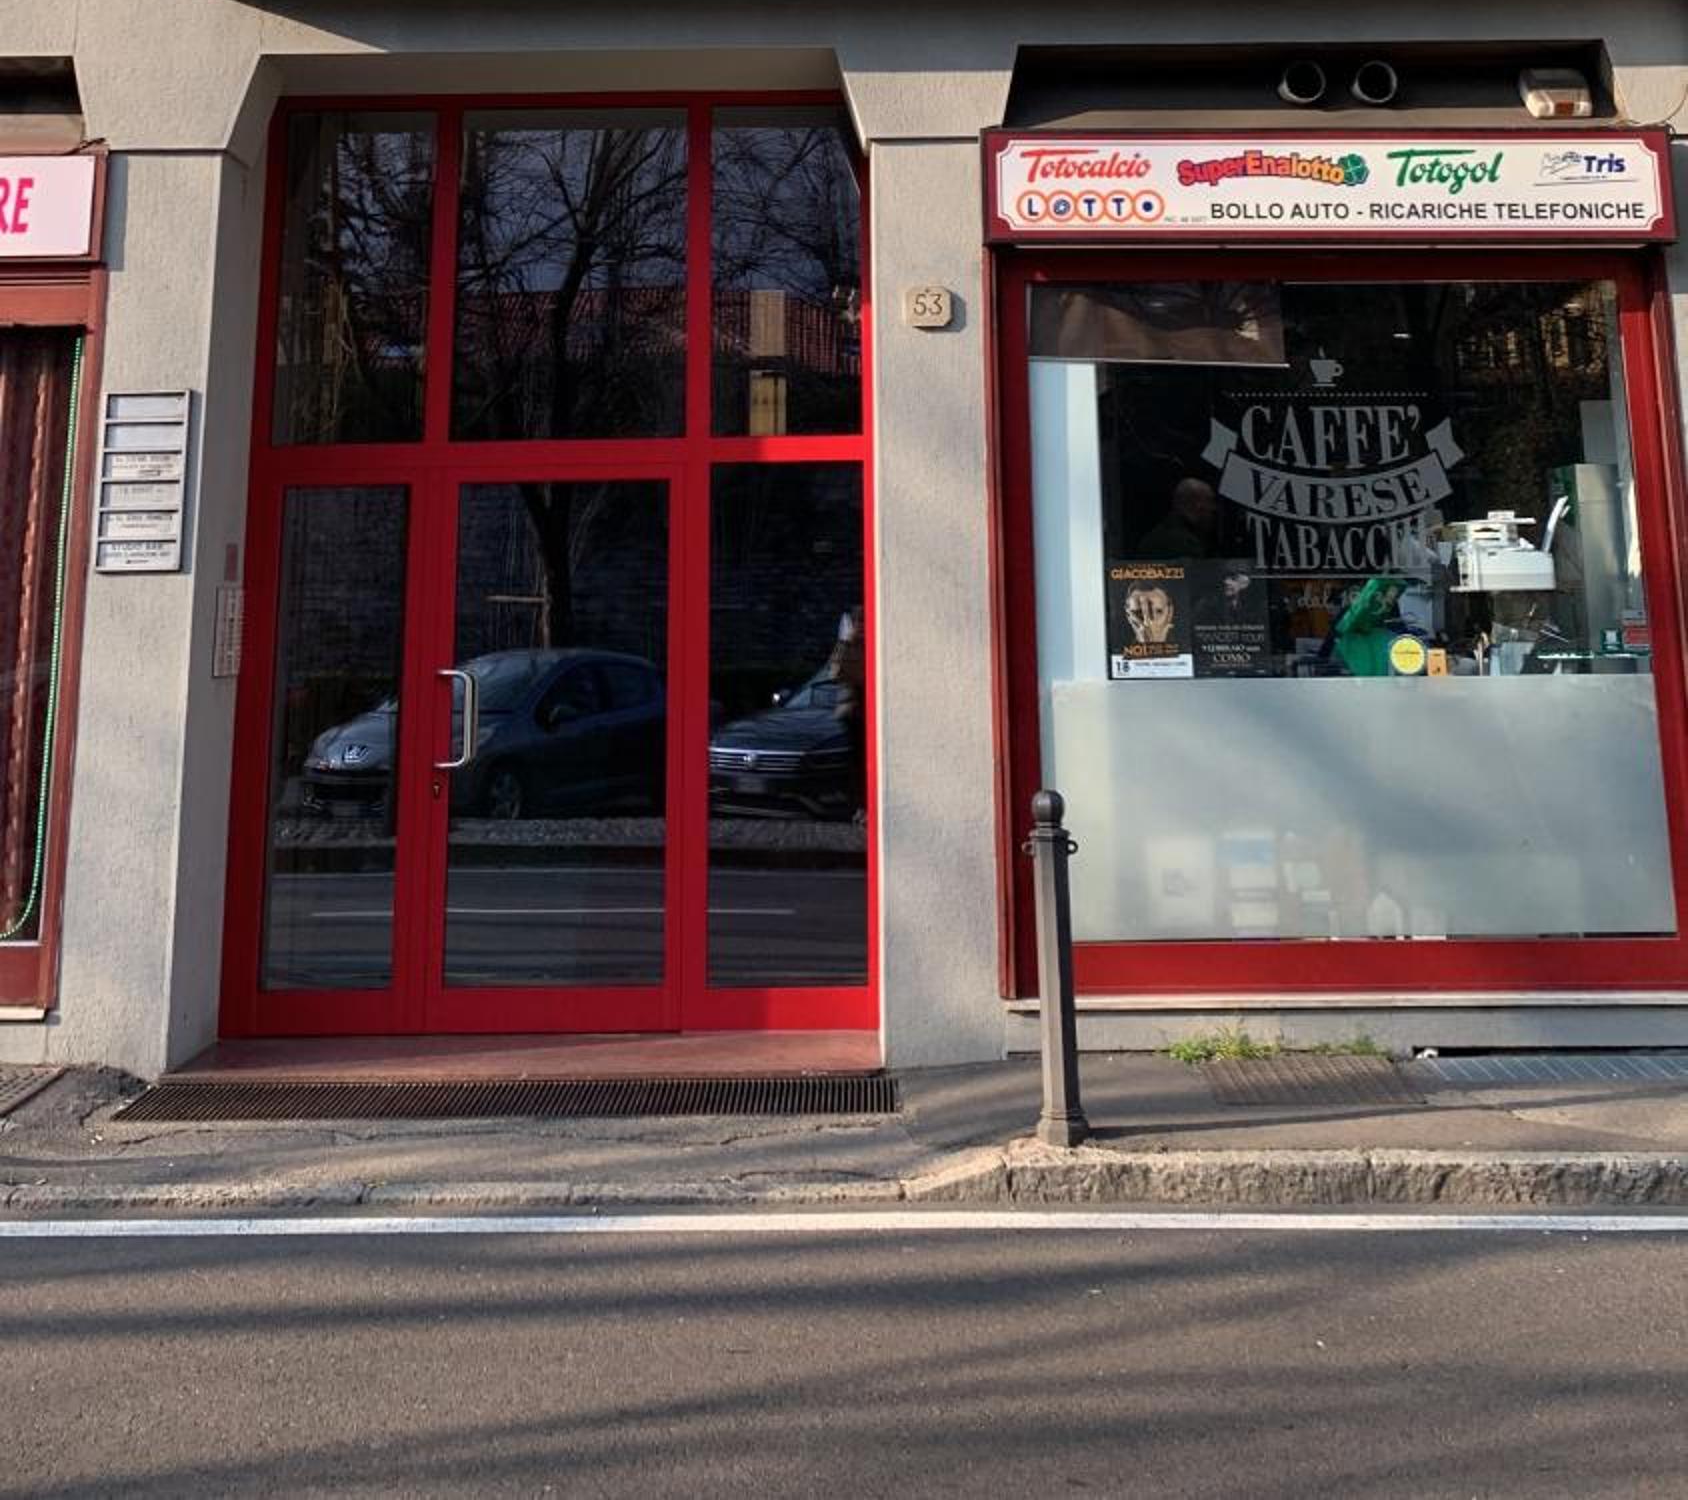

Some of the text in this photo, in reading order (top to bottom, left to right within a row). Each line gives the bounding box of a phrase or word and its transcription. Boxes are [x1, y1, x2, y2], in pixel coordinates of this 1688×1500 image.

[1020, 149, 1152, 183] Totocalcio
[1177, 150, 1345, 186] SuperEnalotto
[1387, 149, 1504, 194] Totogol
[1584, 153, 1625, 173] Tris
[1211, 203, 1284, 219] BOLLO
[1290, 203, 1350, 219] AUTO
[1369, 203, 1487, 219] RICARICHE
[1496, 202, 1645, 219] TELEFONICHE
[913, 293, 943, 316] 53
[1240, 405, 1421, 469] CAFFE'
[1249, 468, 1430, 518] VARESE
[1246, 510, 1431, 570] TABACCHI
